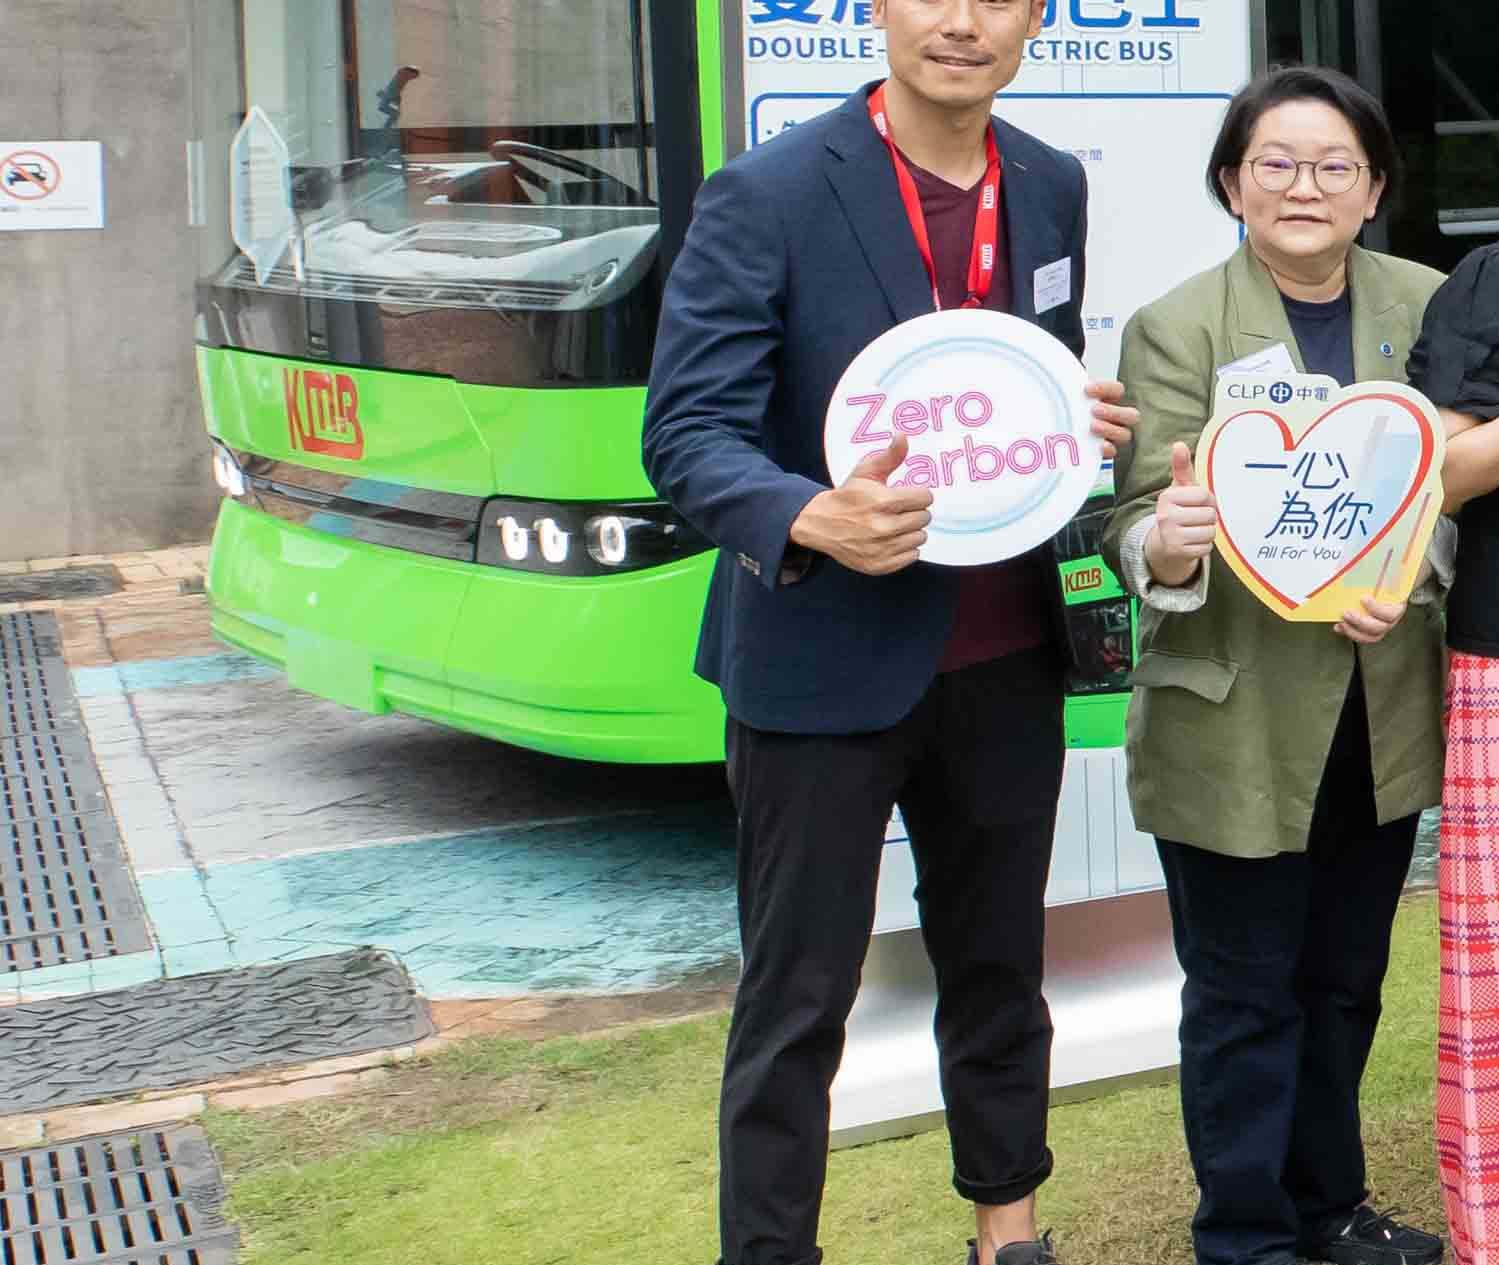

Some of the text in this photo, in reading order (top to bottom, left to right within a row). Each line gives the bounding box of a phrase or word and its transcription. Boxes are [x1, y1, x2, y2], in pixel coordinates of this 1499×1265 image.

[1119, 41, 1173, 61] BUS
[1228, 384, 1265, 400] CLP
[283, 367, 365, 461] KMB
[847, 391, 993, 444] Zero
[1244, 452, 1350, 489] 一心
[1264, 489, 1373, 540] 為你
[1256, 545, 1342, 560] All For You
[1065, 567, 1102, 593] KMB
